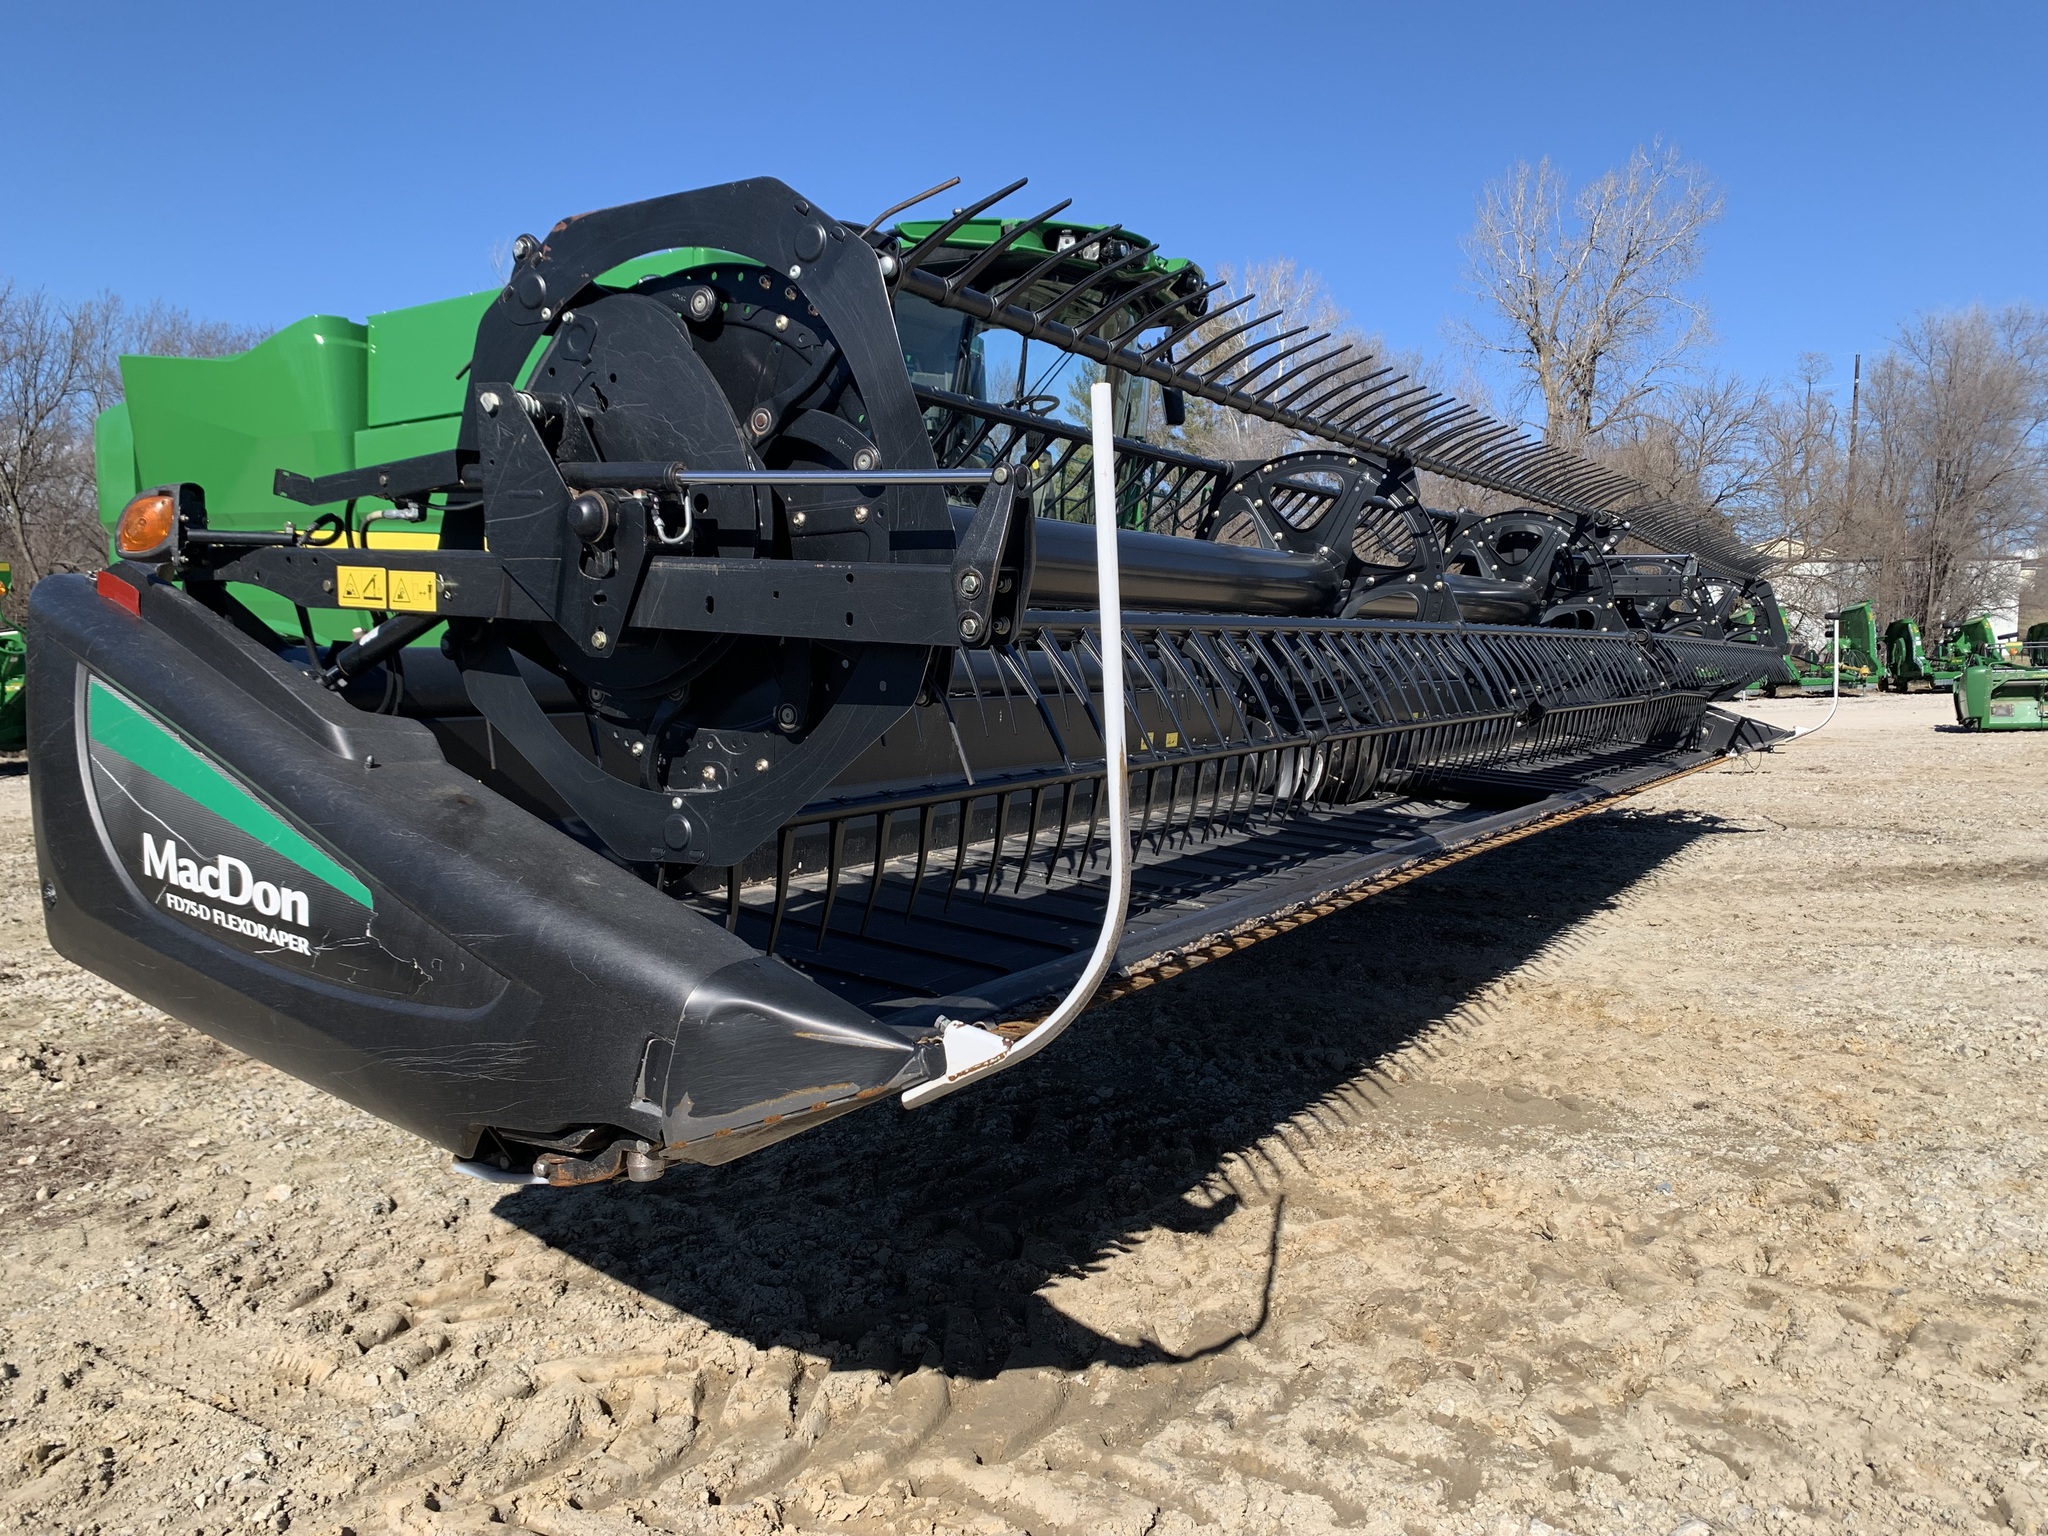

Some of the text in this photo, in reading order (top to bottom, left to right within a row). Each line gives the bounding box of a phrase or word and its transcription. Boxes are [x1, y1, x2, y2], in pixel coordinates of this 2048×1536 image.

[143, 832, 310, 927] MacDon
[166, 892, 312, 956] FD75-D FLEXDRAPER
